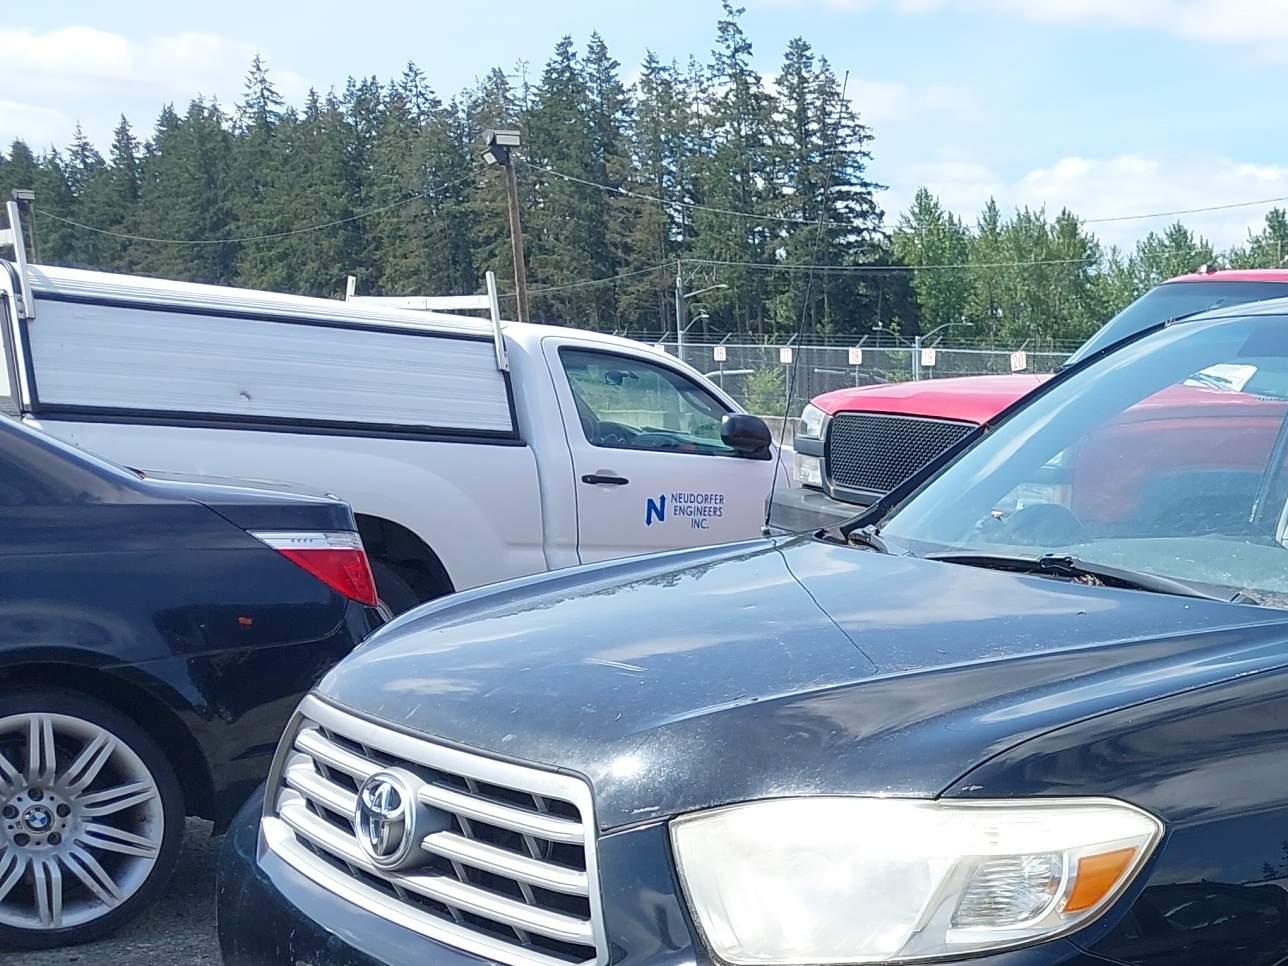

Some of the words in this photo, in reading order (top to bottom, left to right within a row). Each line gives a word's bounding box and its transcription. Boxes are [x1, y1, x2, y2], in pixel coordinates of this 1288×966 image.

[1013, 353, 1024, 370] 20
[670, 493, 725, 505] NEUDORFER
[673, 505, 723, 518] ENGINEERS
[690, 518, 710, 529] INC.
